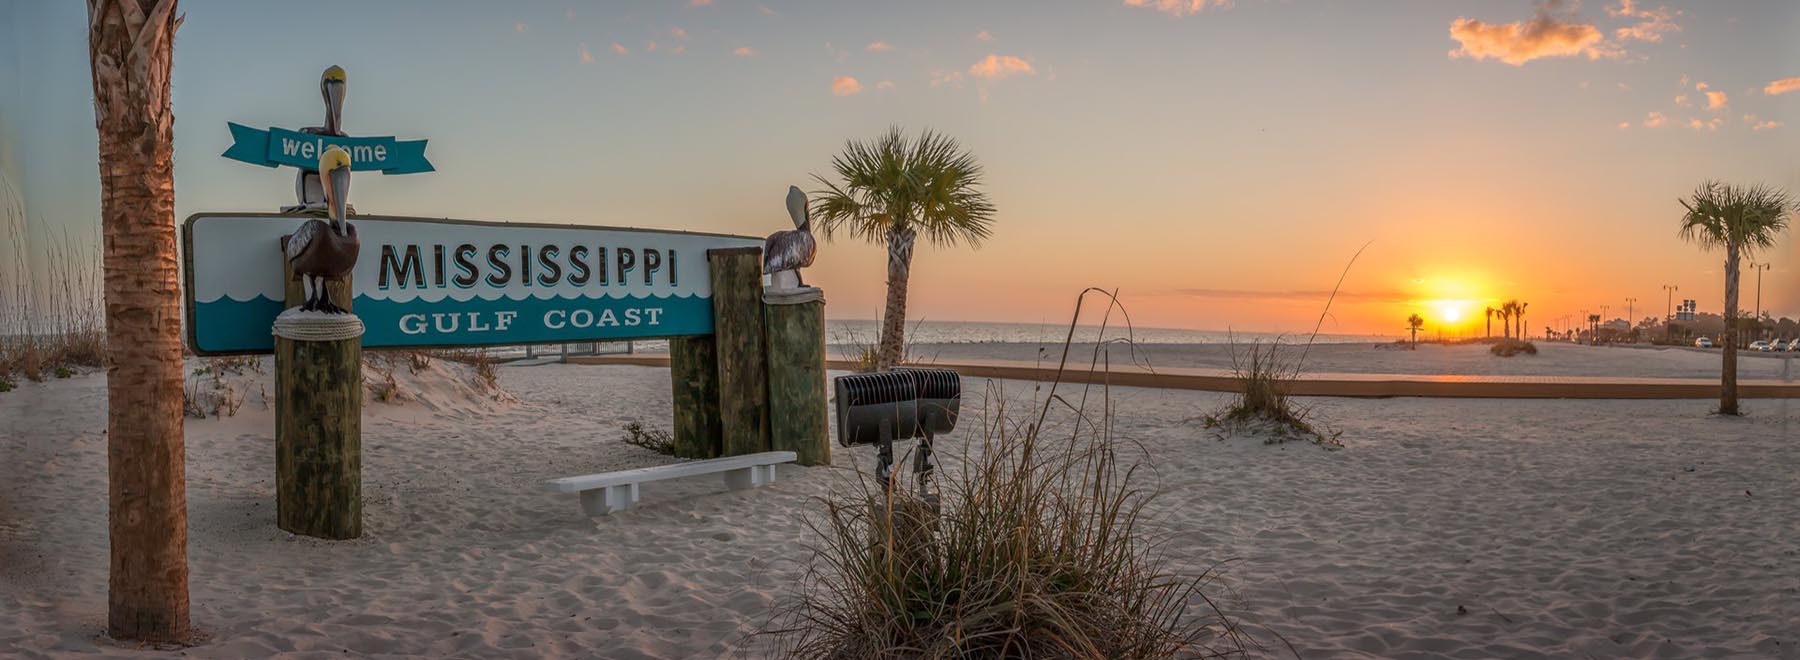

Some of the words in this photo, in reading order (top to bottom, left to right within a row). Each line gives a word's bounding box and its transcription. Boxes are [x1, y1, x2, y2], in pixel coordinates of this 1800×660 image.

[282, 138, 387, 162] welme
[378, 244, 677, 290] MISSISSIPPI
[399, 311, 518, 335] GULF
[543, 308, 663, 329] COAST
